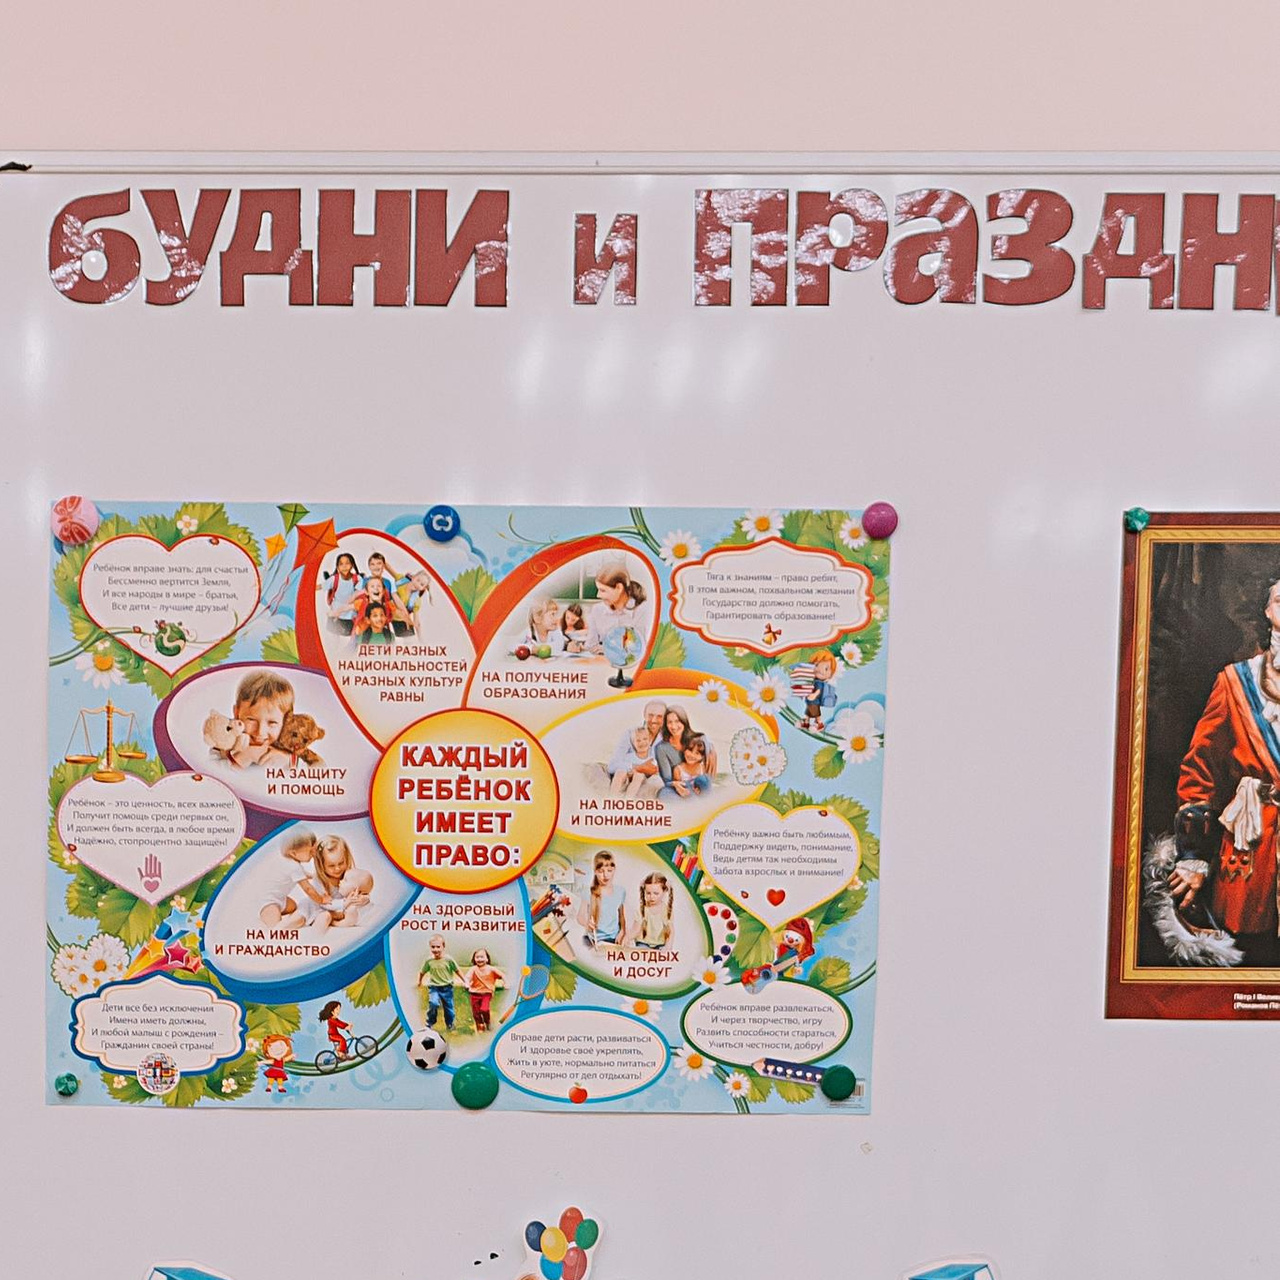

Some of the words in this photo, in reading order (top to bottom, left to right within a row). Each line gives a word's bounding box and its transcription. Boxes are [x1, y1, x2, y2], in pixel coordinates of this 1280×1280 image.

[695, 187, 1280, 316] Праздн
[358, 644, 392, 657] ДЕТИ
[395, 645, 447, 656] РАЗНЫХ
[338, 658, 468, 674] НАЦИОНАЛЬНОСТЕЙ
[342, 676, 351, 687] И
[354, 676, 405, 687] РАЗНЫХ
[409, 676, 463, 688] КУЛЬТУР
[481, 672, 500, 682] НА
[505, 672, 589, 684] ПОЛУЧЕНИЕ
[380, 691, 425, 702] РАВНЫ
[483, 687, 586, 699] ОБРАЗОВАНИЯ
[402, 742, 527, 771] КАЖДЫЙ
[266, 768, 285, 779] НА
[290, 768, 347, 781] ЗАЩИТУ
[268, 784, 276, 794] И
[281, 784, 344, 796] ПОМОЩЬ
[398, 775, 531, 801] РЕБЁНОК
[579, 800, 599, 811] НА
[602, 800, 664, 811] ЛЮБОВЬ
[417, 812, 511, 833] ИМЕЕТ
[571, 815, 580, 825] И
[584, 815, 672, 827] ПОНИМАНИЕ
[416, 845, 519, 866] ПРАВО:
[413, 905, 431, 915] НА
[436, 904, 514, 917] ЗДОРОВЫЙ
[401, 920, 437, 930] РОСТ
[442, 921, 450, 930] И
[455, 921, 526, 932] РАЗВИТИЕ
[246, 930, 266, 940] НА
[270, 930, 299, 940] ИМЯ
[215, 945, 223, 955] И
[228, 944, 330, 958] ГРАЖДАНСТВО
[607, 951, 628, 962] НА
[631, 951, 679, 963] ОТДЫХ
[613, 966, 623, 977] И
[626, 966, 672, 979] ДОСУГ
